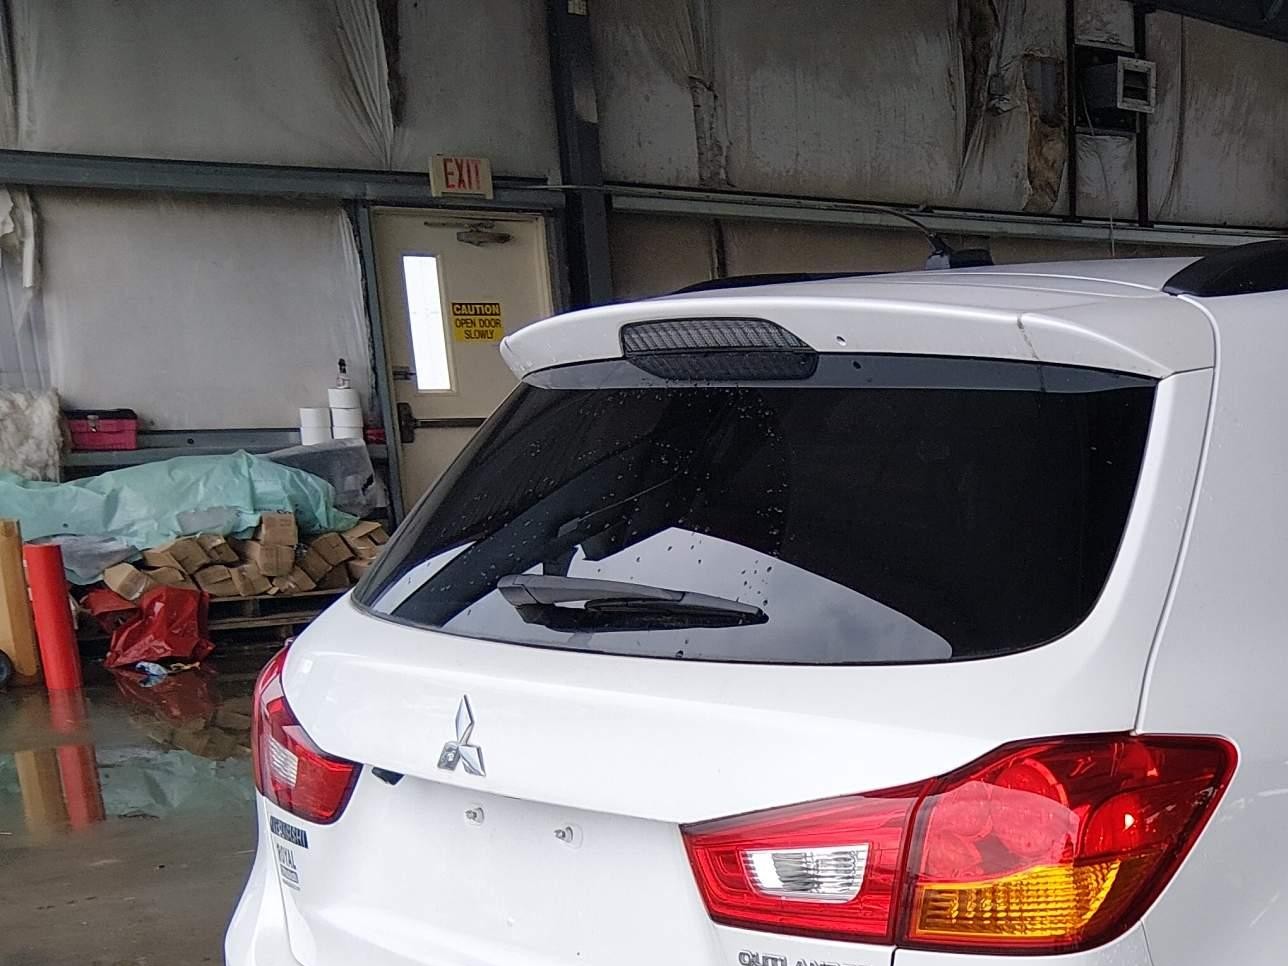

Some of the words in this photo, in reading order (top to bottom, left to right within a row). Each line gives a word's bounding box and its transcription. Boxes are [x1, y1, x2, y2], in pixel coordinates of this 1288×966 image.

[442, 158, 481, 191] EXIT
[453, 303, 500, 315] CAUTION
[455, 318, 477, 328] OPEN
[479, 318, 502, 328] DOOR
[464, 329, 494, 339] SLOWLY
